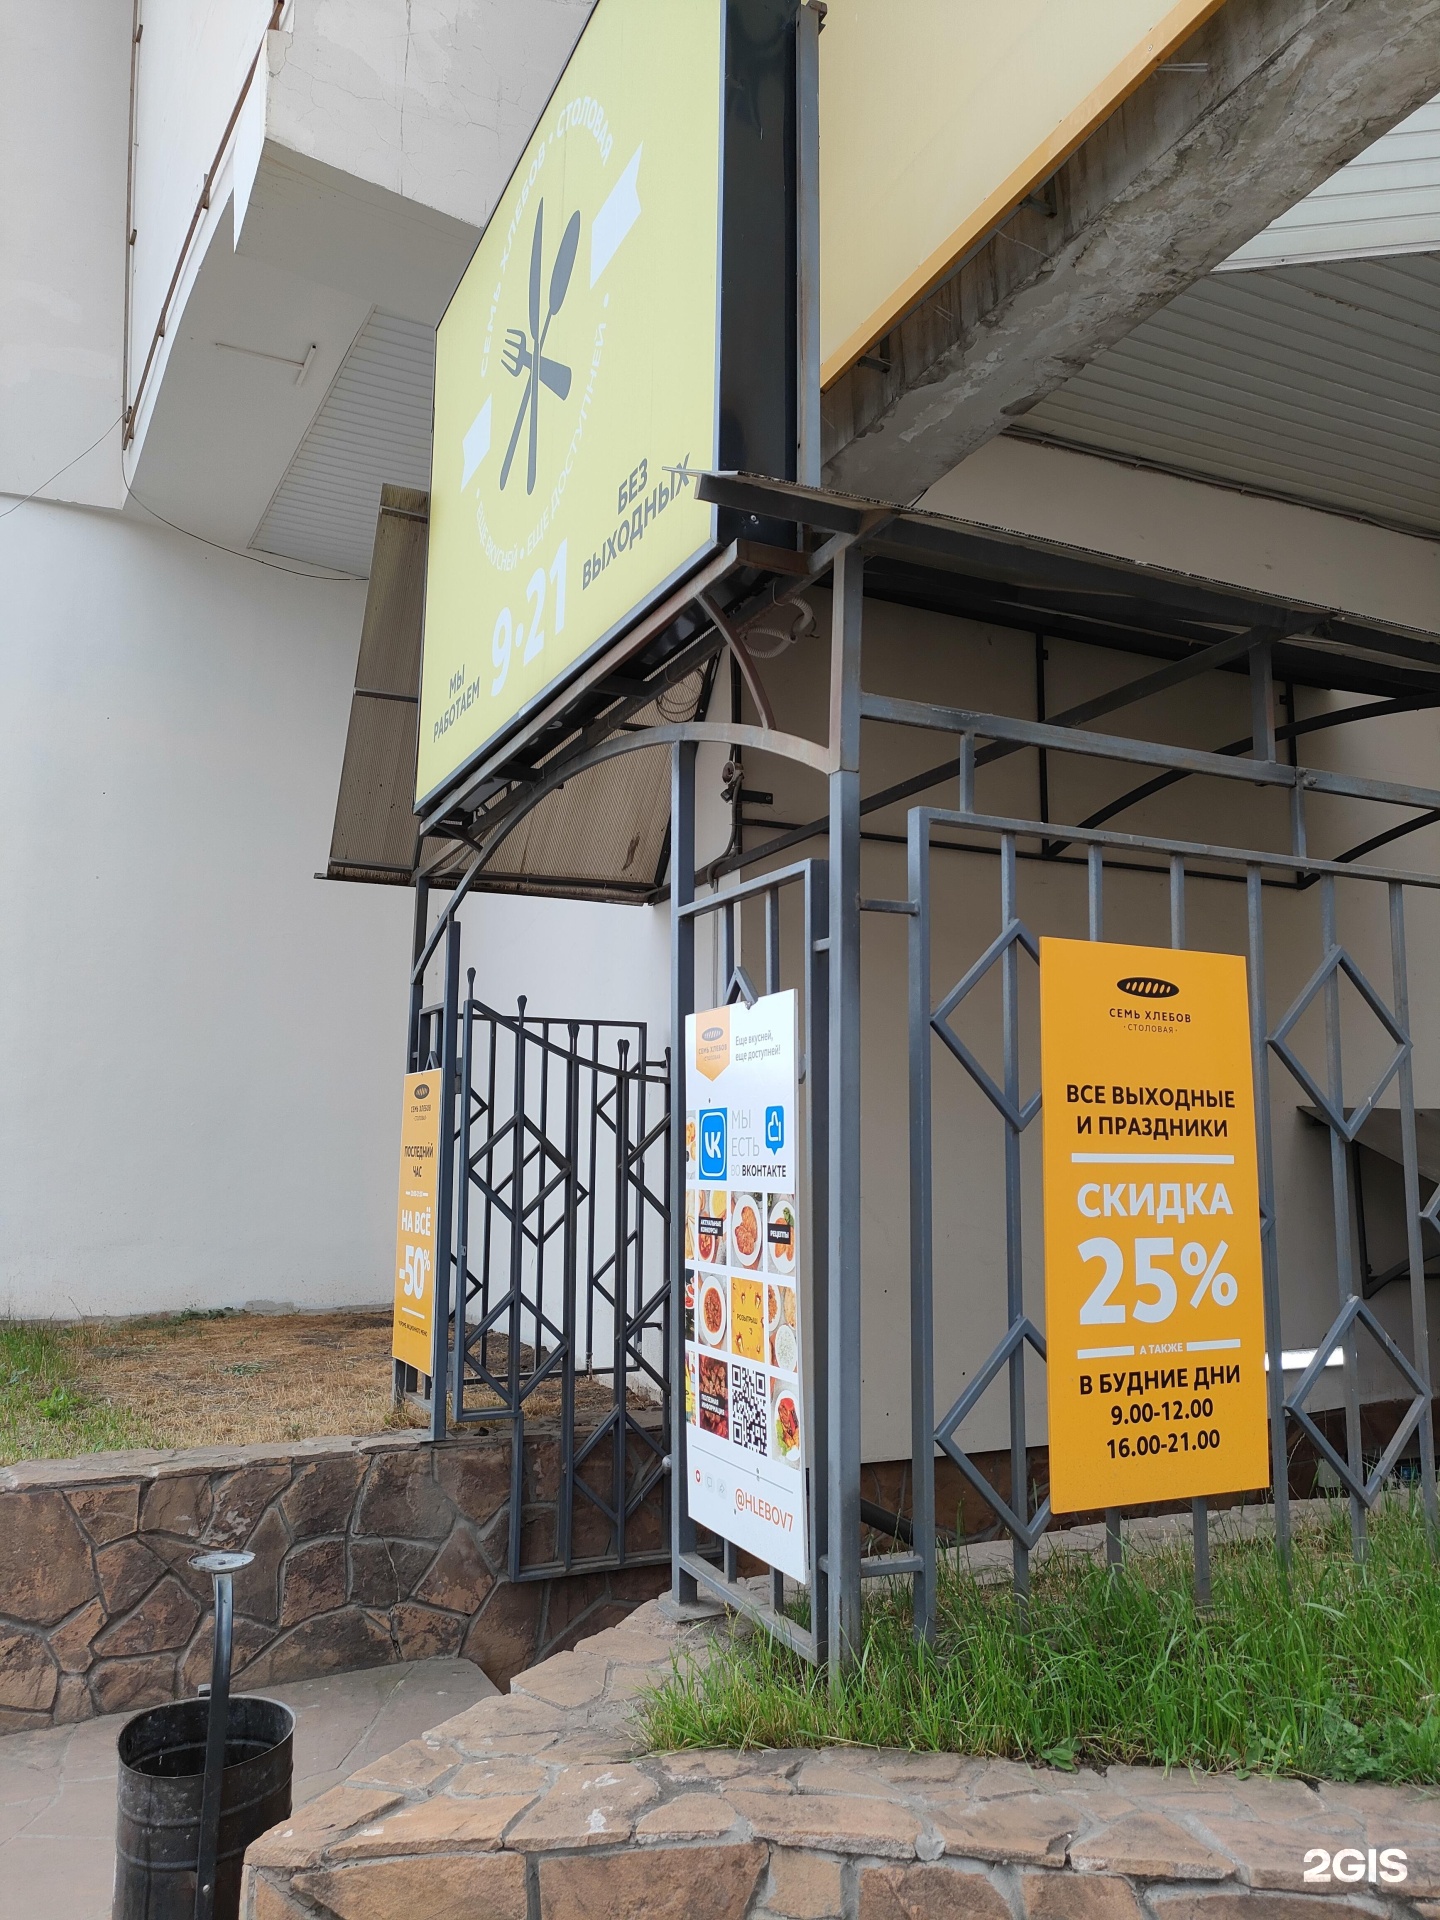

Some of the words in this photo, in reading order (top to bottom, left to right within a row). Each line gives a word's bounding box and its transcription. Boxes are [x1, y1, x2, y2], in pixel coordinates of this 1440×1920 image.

[556, 95, 614, 166] СТОЛОВАЯ
[480, 282, 501, 378] СЕМЬ
[500, 141, 546, 273] ХЛЕБОВ
[617, 457, 649, 516] БЕЗ
[582, 452, 691, 591] ВЫХОДНЫХ
[449, 664, 466, 700] МЫ
[433, 676, 481, 744] РАБОТАЕМ
[1109, 1008, 1141, 1020] СЕМЬ
[1144, 1010, 1192, 1023] ХЛЕБОВ
[748, 1030, 774, 1044] вкусней,
[748, 1044, 781, 1061] доступней!
[1066, 1084, 1106, 1104] ВСЕ
[1112, 1086, 1236, 1111] ВЫХОДНЫЕ
[731, 1109, 751, 1130] МЫ
[1077, 1116, 1092, 1135] И
[1099, 1116, 1229, 1141] ПРАЗДНИКИ
[404, 1142, 434, 1161] ПОСЛЕДНИЙ
[731, 1136, 760, 1157] ЕСТЬ
[412, 1166, 423, 1178] ЧАС
[741, 1164, 787, 1178] ВКОНТАКТЕ
[1077, 1182, 1234, 1224] СКИДКА
[401, 1209, 413, 1233] НА
[414, 1206, 431, 1237] ВСЁ
[1077, 1237, 1238, 1325] 25%
[1140, 1345, 1148, 1356] А
[1148, 1342, 1184, 1355] ТАКЖЕ
[1079, 1375, 1093, 1395] В
[1099, 1368, 1189, 1396] БУДНИЕ
[1193, 1364, 1241, 1390] ДНИ
[1110, 1398, 1214, 1425] 9.00-12.00
[1106, 1429, 1221, 1459] 16.00-21.00
[735, 1488, 794, 1532] @HLEBOV7
